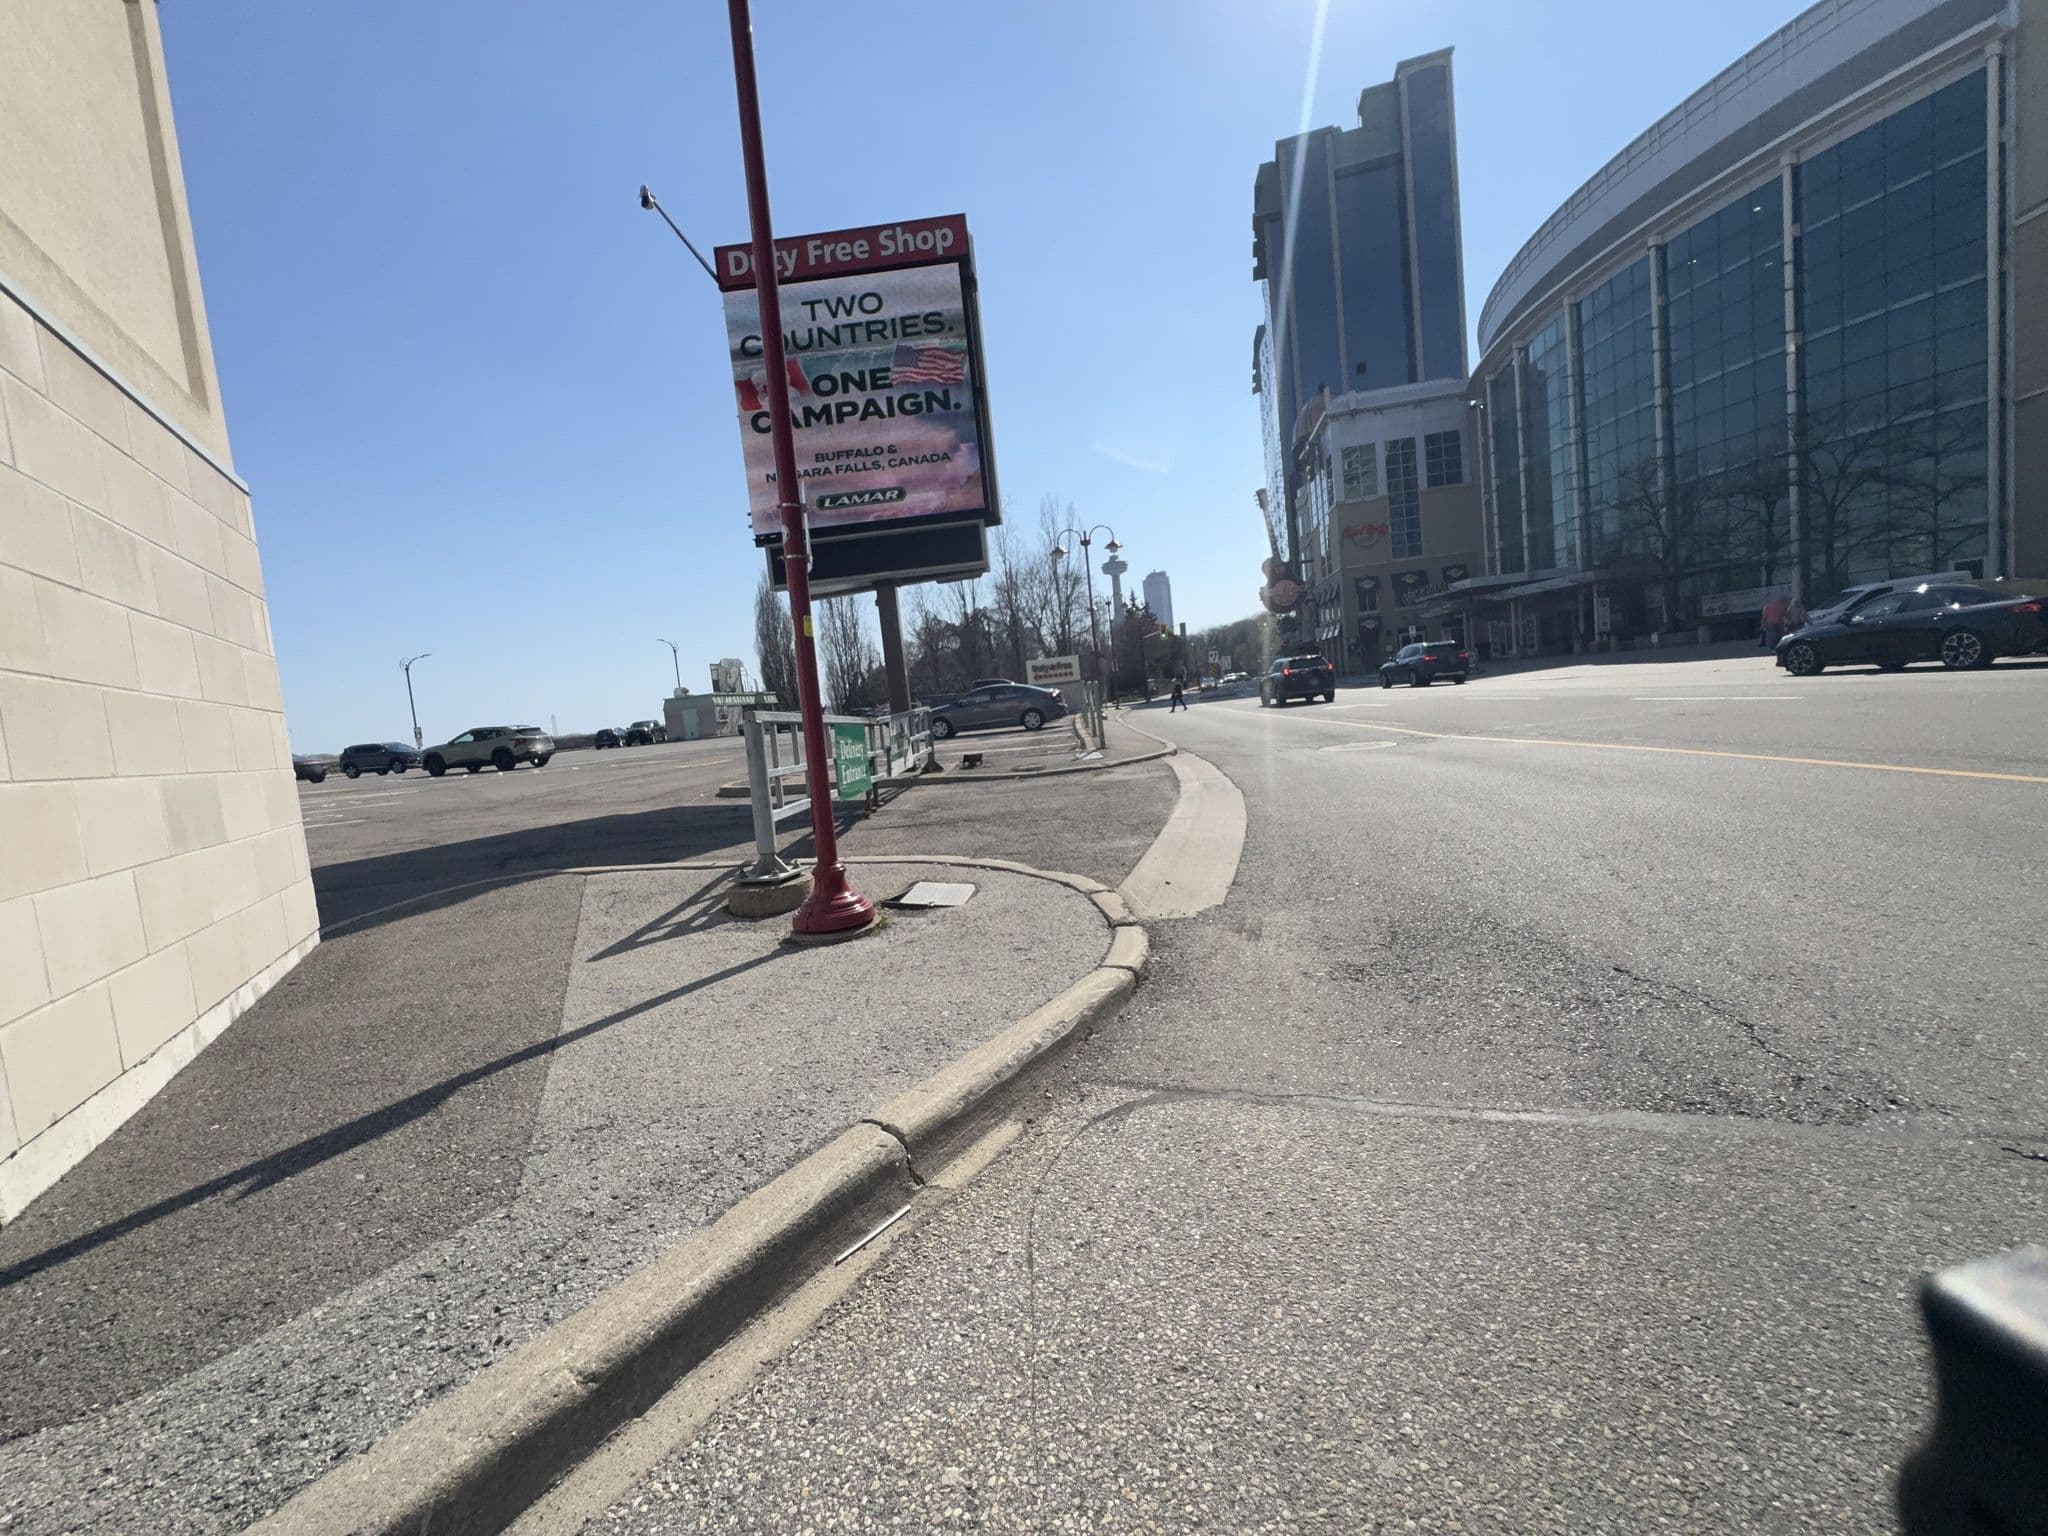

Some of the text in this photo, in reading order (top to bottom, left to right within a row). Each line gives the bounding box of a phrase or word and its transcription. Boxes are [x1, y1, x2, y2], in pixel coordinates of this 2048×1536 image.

[727, 226, 954, 277] Dty Free Shop
[801, 291, 884, 322] TWO
[740, 311, 954, 357] CUNTRIES.
[811, 366, 894, 397] ONE
[814, 444, 898, 463] BUFFALO &
[835, 459, 885, 474] FALLS,
[887, 452, 952, 468] CANADA
[824, 490, 899, 507] LAMAR
[839, 740, 864, 761] Delivery
[841, 764, 867, 785] Entrance
